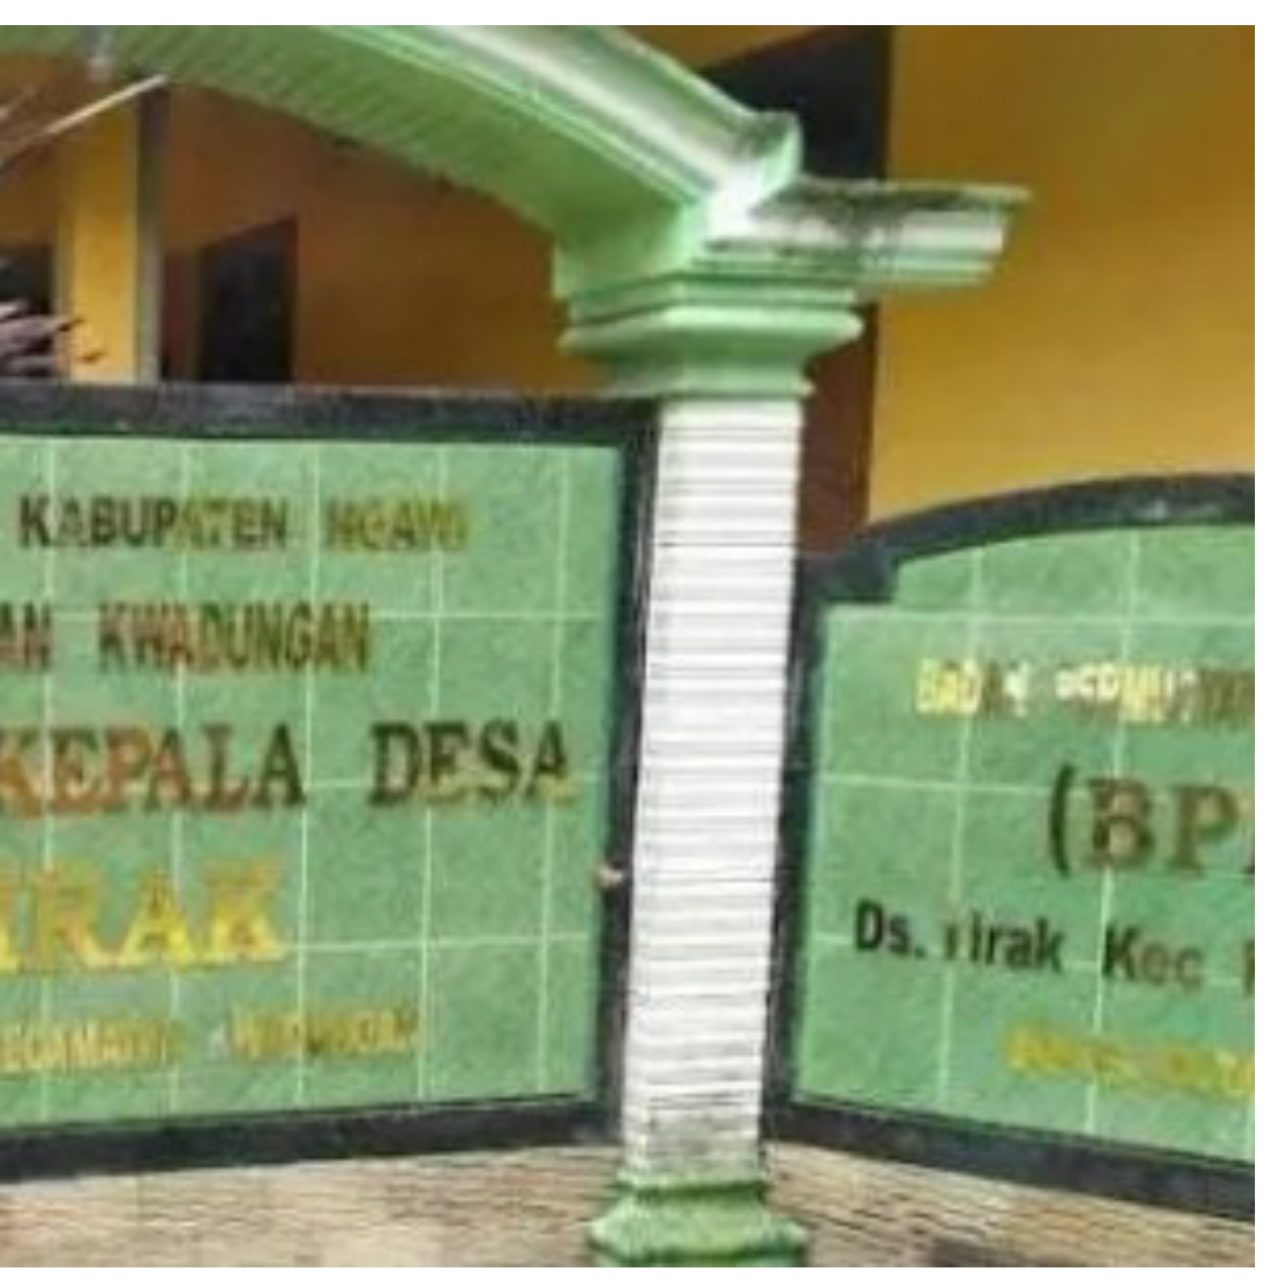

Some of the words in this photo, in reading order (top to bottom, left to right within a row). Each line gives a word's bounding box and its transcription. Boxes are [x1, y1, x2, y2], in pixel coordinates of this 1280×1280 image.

[20, 494, 287, 550] KABUPATEN
[96, 600, 372, 673] KWADUNGAN
[368, 718, 580, 808] DESA
[1048, 762, 1255, 878] (BP
[855, 900, 926, 958] Ds.
